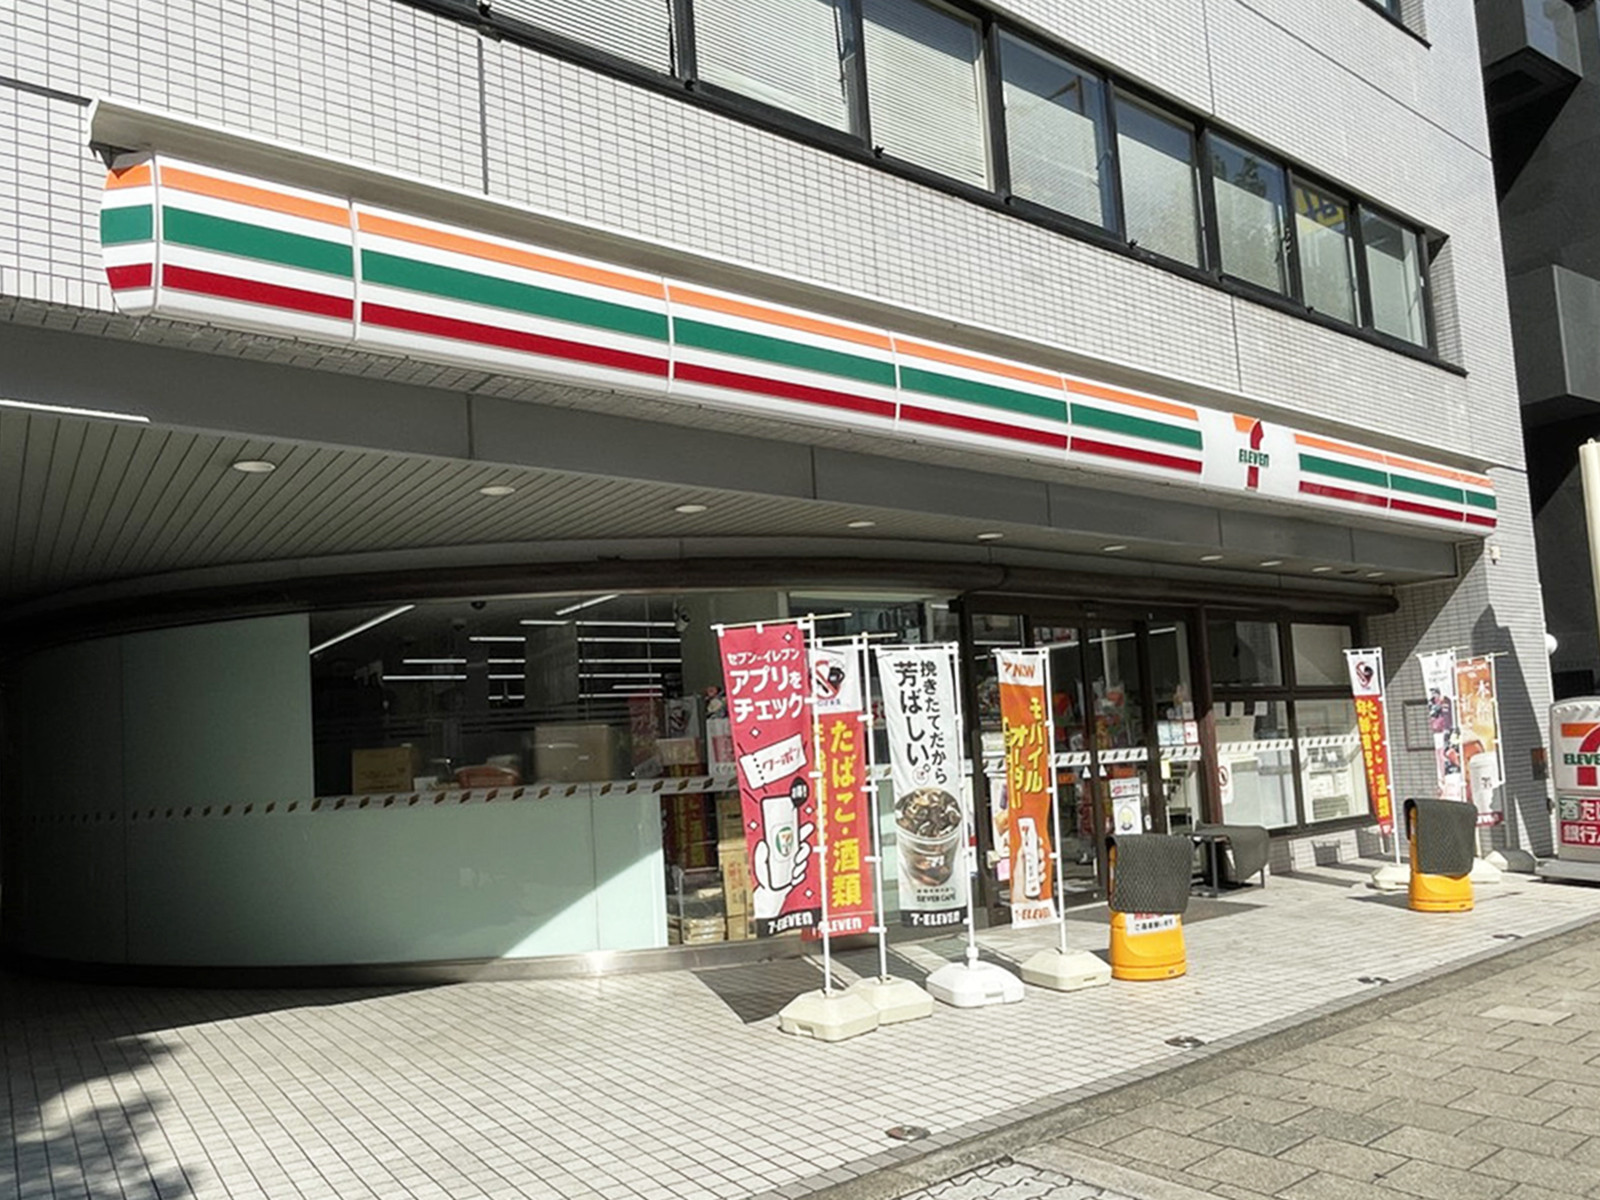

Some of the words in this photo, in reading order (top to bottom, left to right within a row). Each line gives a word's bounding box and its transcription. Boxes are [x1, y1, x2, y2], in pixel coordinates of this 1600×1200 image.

[1238, 448, 1270, 468] ELEVEn
[729, 664, 803, 696] アプリを
[733, 692, 804, 723] チェック
[893, 660, 931, 773] 芳ばしい。
[920, 660, 948, 785] 挽きたてだから
[1010, 724, 1029, 809] オーダー
[1025, 697, 1044, 793] モバイル
[830, 720, 862, 908] たばこ・酒類
[1563, 824, 1600, 844] 銀行
